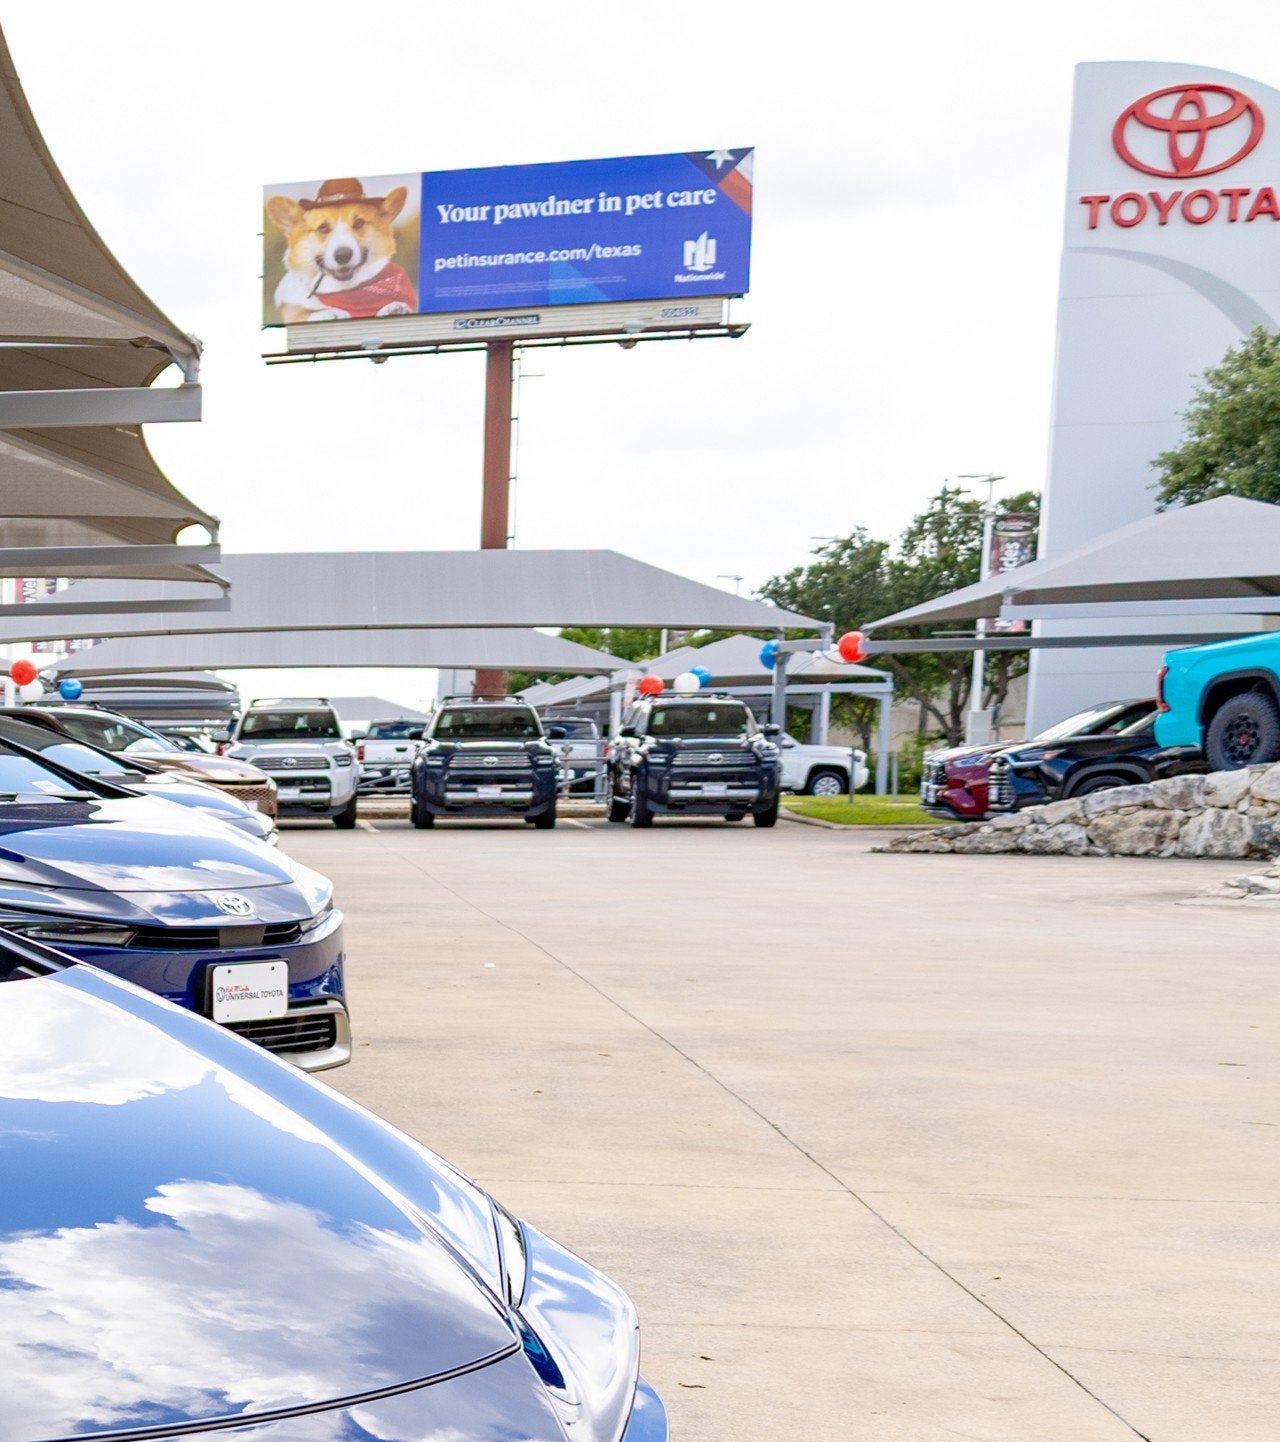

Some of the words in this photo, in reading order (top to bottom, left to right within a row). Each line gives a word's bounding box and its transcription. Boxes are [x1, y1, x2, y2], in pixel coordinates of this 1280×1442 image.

[437, 204, 488, 224] Your
[493, 195, 595, 225] pawdner
[597, 192, 621, 213] in
[624, 189, 663, 215] pet
[666, 188, 717, 207] care
[1080, 187, 1280, 230] TOYOTA
[434, 242, 642, 272] petinsurance.com/texas
[674, 271, 725, 284] Nationwide
[225, 990, 259, 1001] UNIVERSAL
[261, 990, 284, 999] TOYOTA
